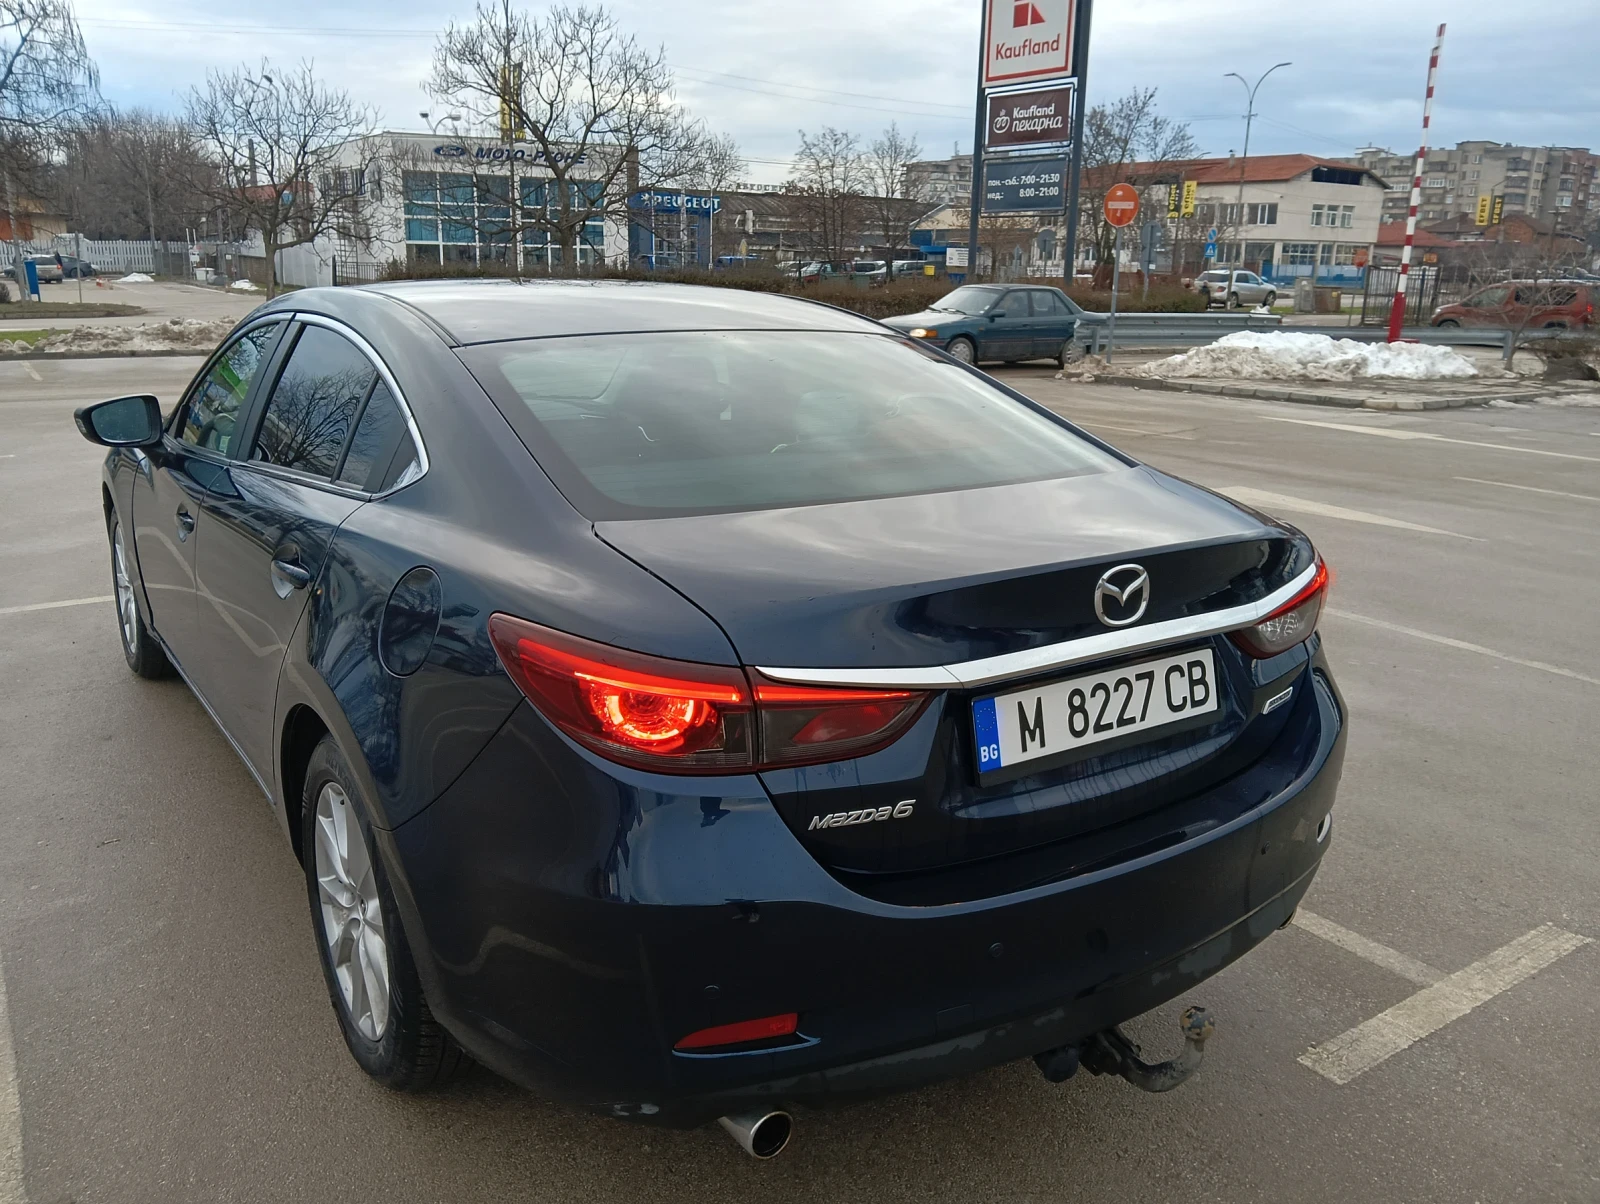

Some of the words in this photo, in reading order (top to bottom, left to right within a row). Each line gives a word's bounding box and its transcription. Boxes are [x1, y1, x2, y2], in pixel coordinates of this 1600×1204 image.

[996, 33, 1060, 60] Kaufland
[1013, 103, 1055, 119] Kaufland
[1012, 115, 1063, 133] пекарна
[653, 195, 720, 209] PEUGEOT
[1017, 697, 1046, 753] M
[1067, 670, 1155, 739] 8227
[1163, 658, 1210, 714] CB
[979, 743, 999, 762] BG
